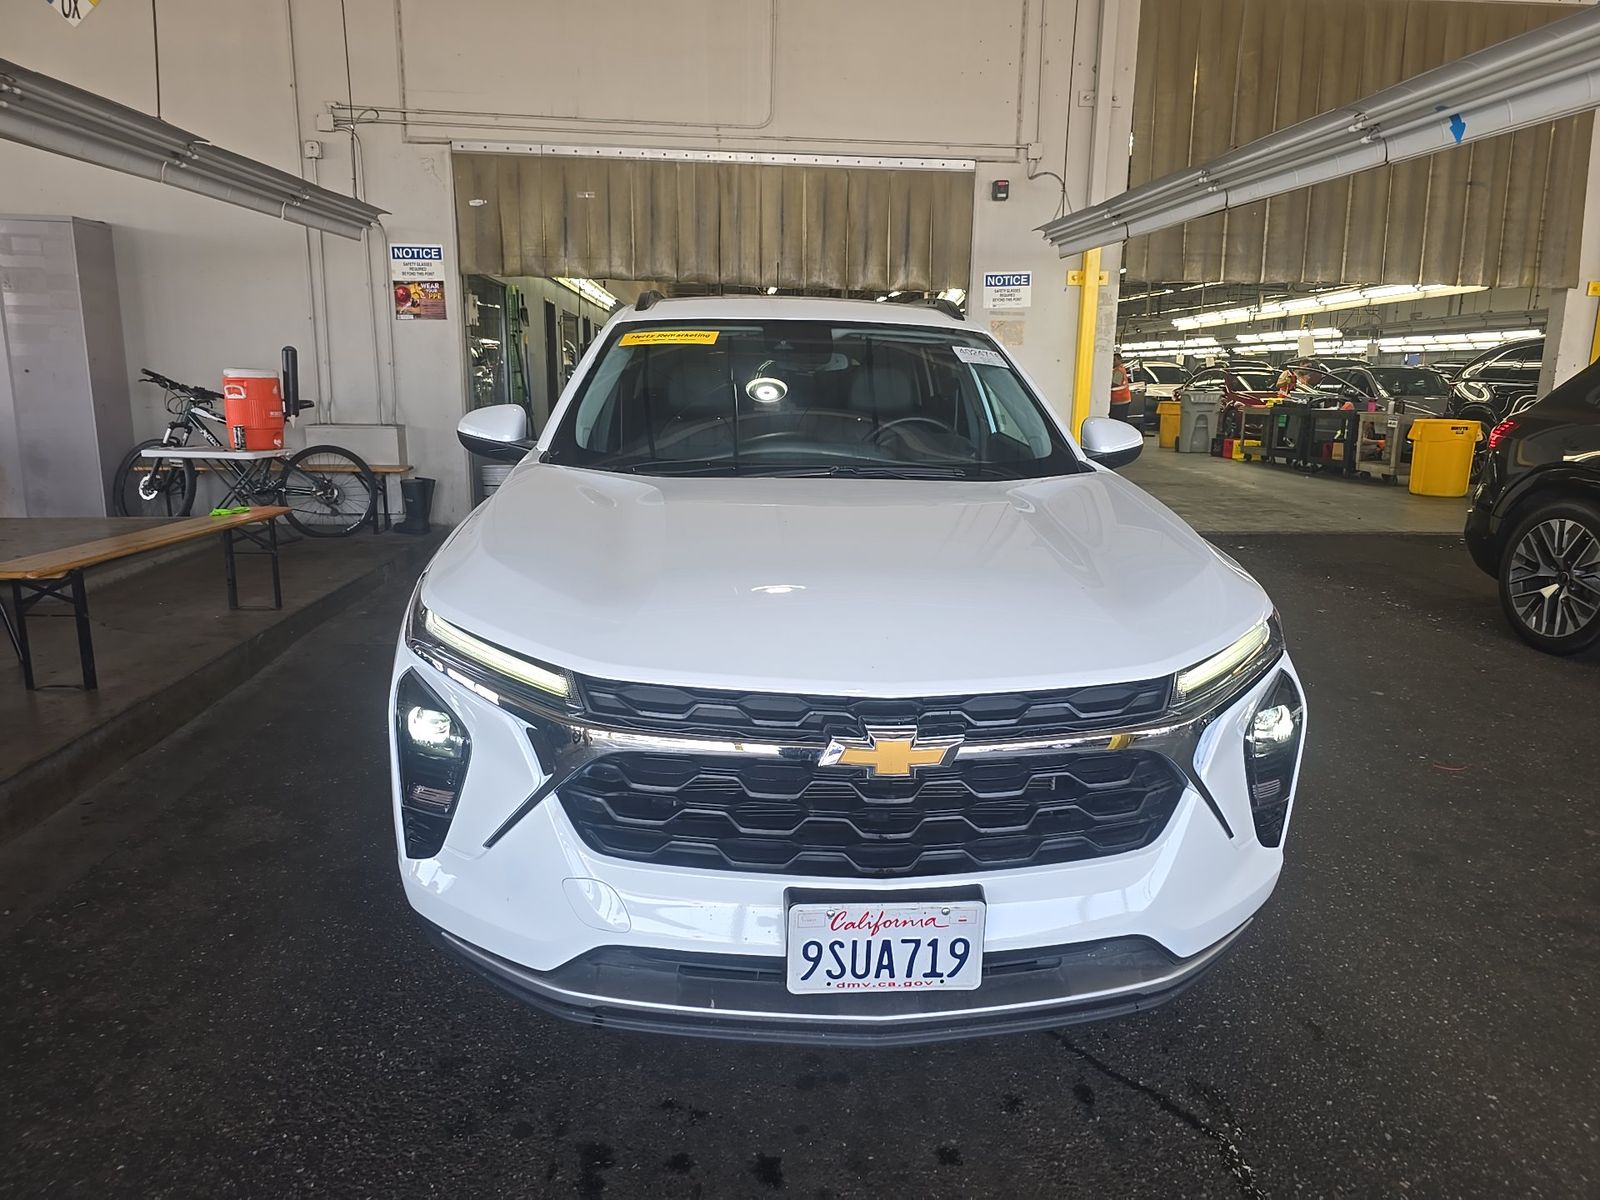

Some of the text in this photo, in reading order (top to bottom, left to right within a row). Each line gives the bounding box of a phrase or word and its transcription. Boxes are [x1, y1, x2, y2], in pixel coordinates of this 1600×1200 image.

[394, 248, 440, 259] NOTICE
[987, 275, 1029, 286] NOTICE
[830, 911, 949, 936] California
[800, 938, 971, 981] 9SUA719
[836, 980, 934, 989] dmv.ca.gov
